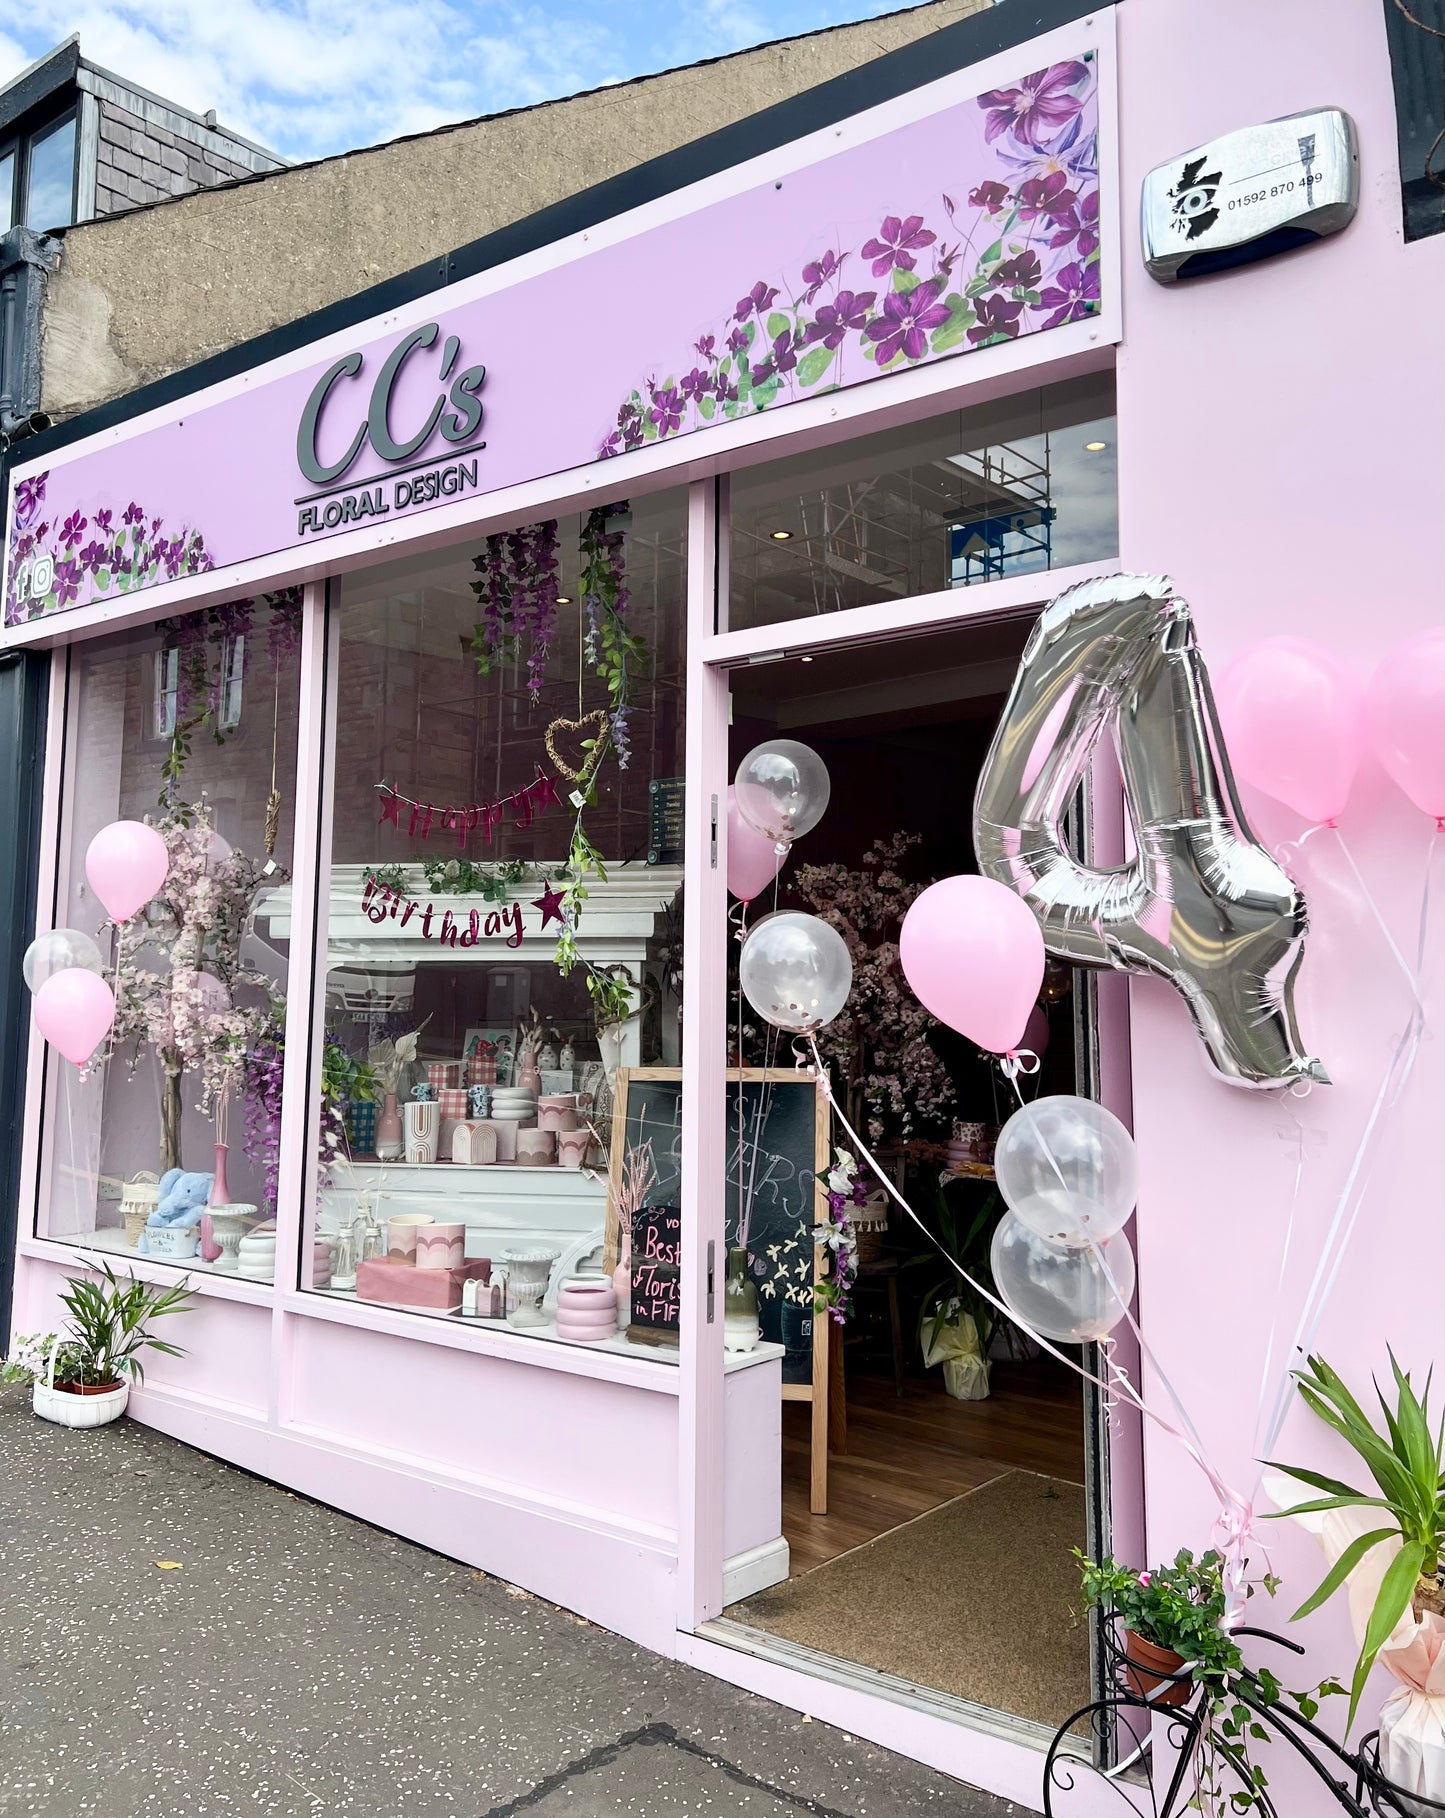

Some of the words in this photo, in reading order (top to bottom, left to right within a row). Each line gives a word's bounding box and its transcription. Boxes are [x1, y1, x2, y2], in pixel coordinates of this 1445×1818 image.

[1227, 190, 1267, 211] 01592
[1270, 181, 1294, 197] 870
[1298, 172, 1323, 187] 499
[297, 322, 485, 484] CC's
[298, 487, 389, 535] FLORAL
[394, 459, 477, 508] DESIGN
[408, 784, 534, 849] Happy
[361, 875, 527, 949] Birthday
[644, 1226, 682, 1266] Best
[635, 1300, 648, 1316] in
[651, 1299, 681, 1322] FIF
